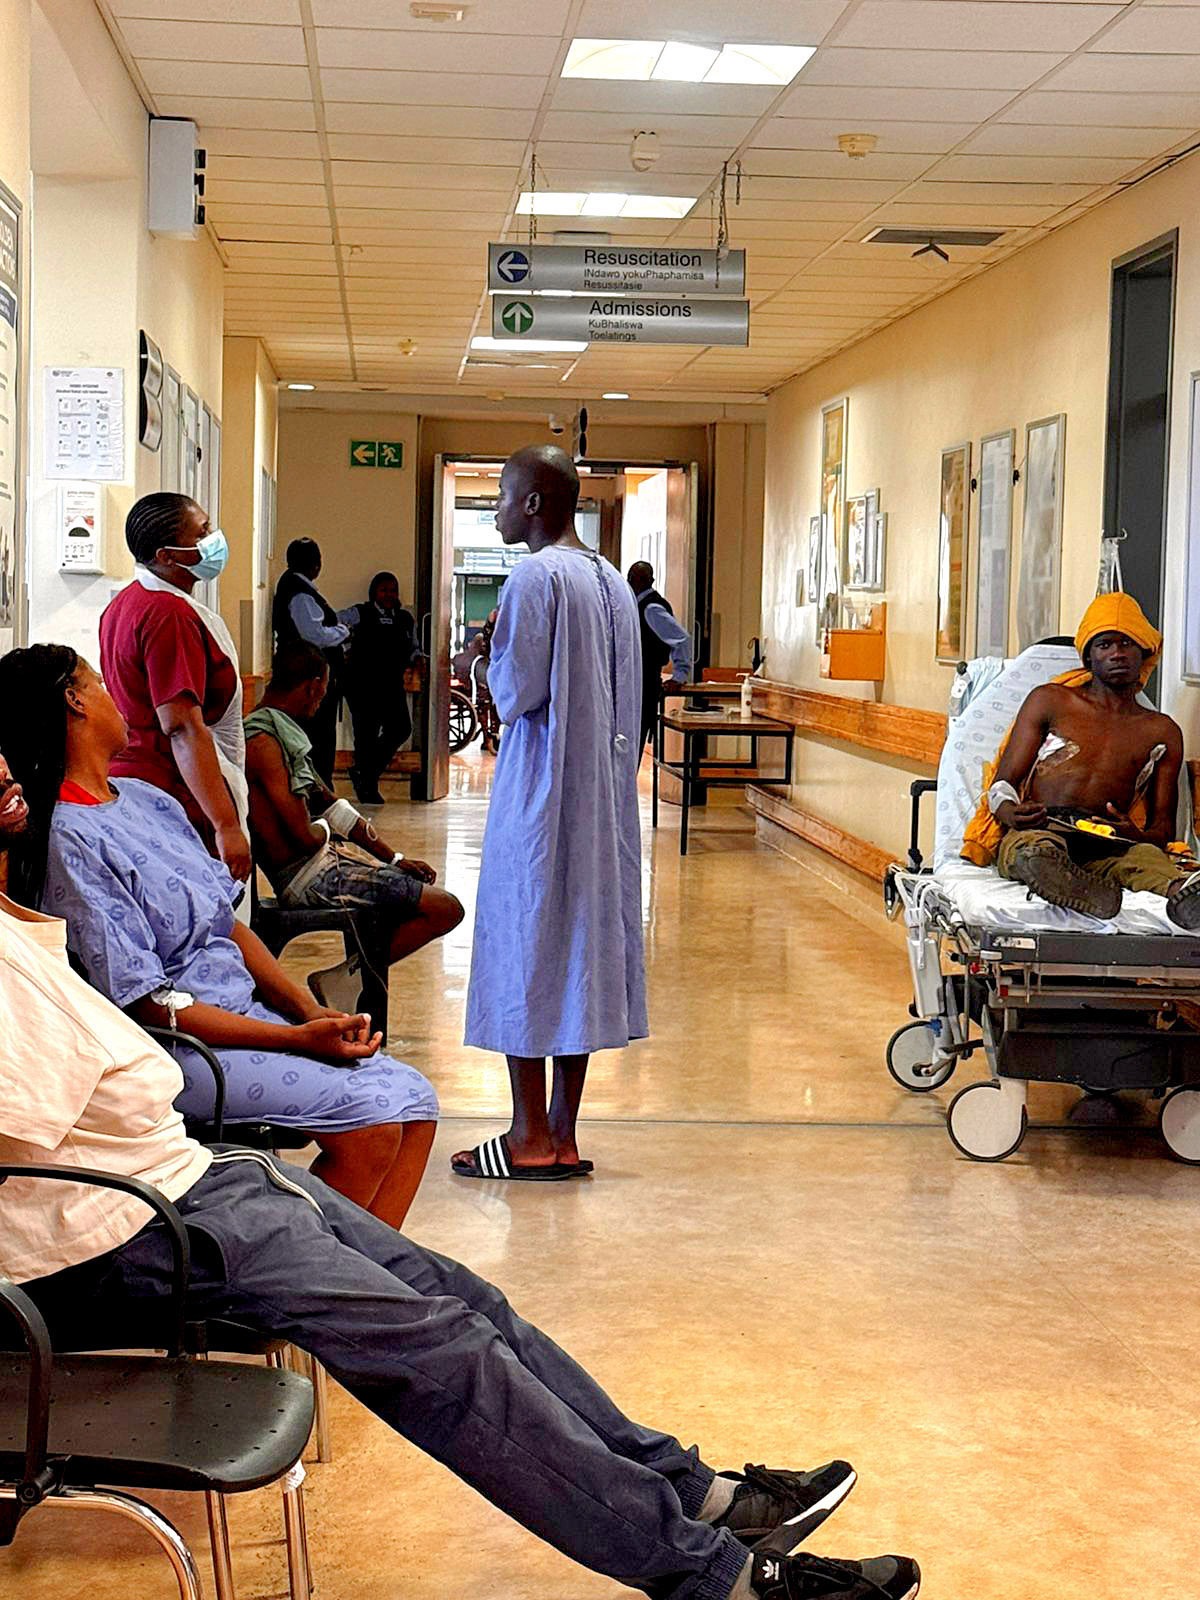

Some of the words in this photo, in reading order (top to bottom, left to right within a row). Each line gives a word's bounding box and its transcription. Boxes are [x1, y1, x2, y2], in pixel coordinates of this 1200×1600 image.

[584, 249, 702, 267] Resuscitation
[583, 269, 621, 279] INdawo
[623, 270, 705, 281] yokuPhaphamisa
[583, 280, 643, 290] Resussitasie
[589, 300, 692, 317] Admissions
[588, 319, 643, 329] KuBhaliswa
[588, 330, 637, 341] Toelatings
